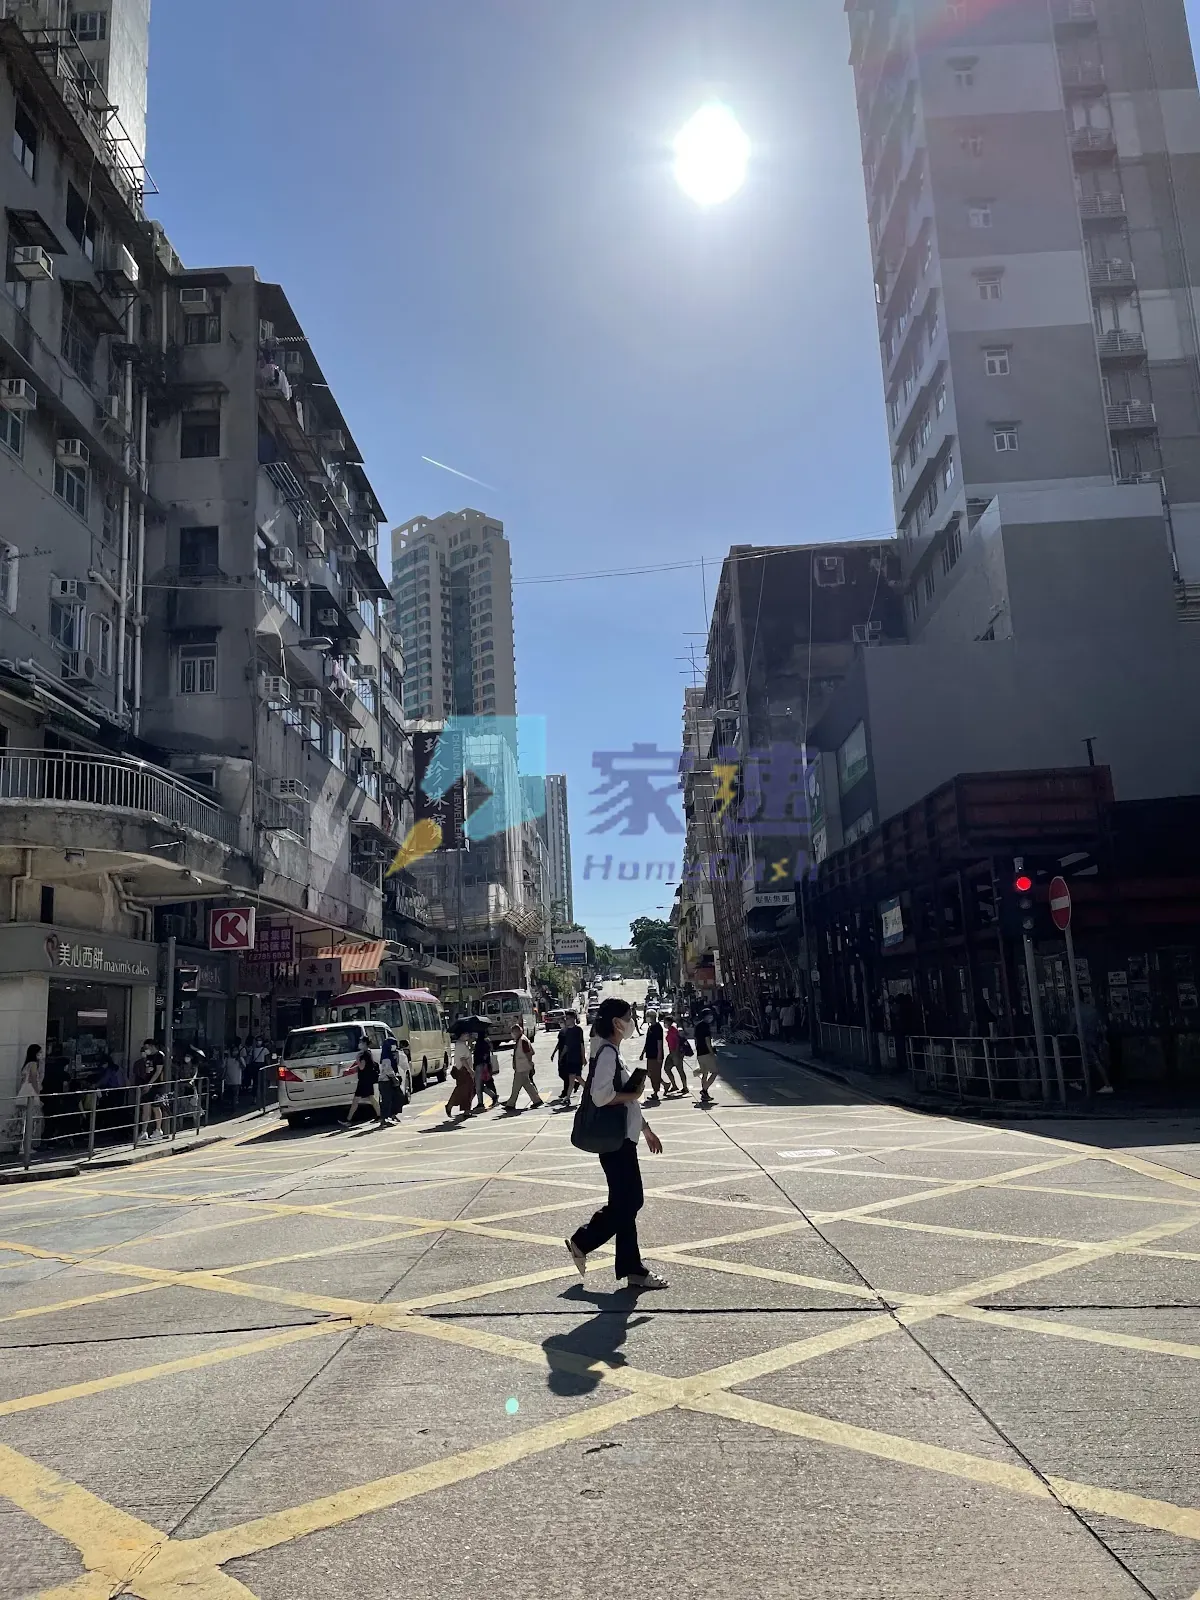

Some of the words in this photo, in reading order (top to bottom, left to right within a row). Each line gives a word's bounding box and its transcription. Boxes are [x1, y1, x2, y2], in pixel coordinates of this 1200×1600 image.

[452, 733, 460, 760] CHUN
[59, 942, 104, 970] 美心西餅
[104, 958, 131, 974] maxim's
[132, 960, 150, 976] cakes
